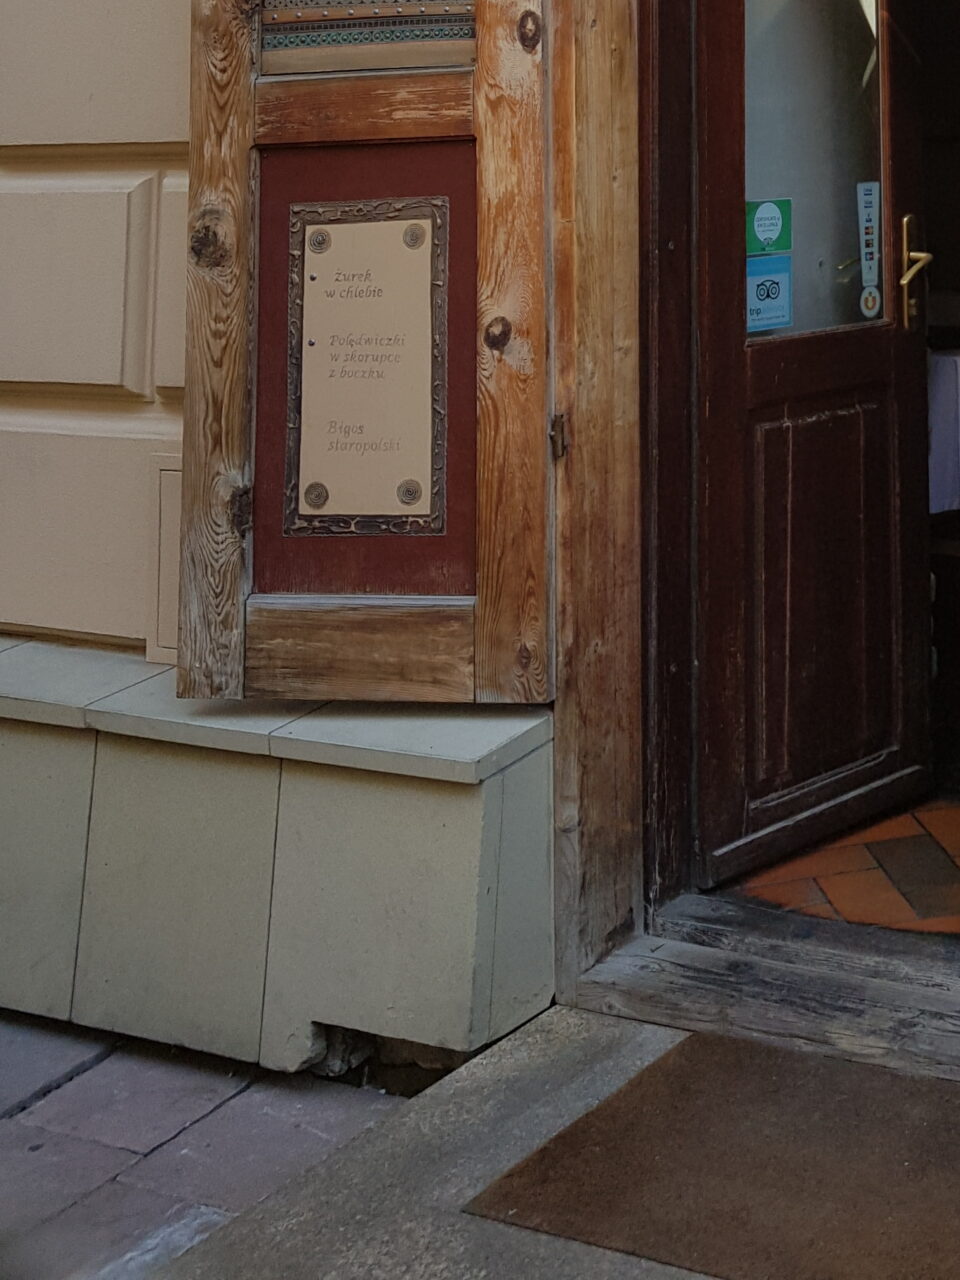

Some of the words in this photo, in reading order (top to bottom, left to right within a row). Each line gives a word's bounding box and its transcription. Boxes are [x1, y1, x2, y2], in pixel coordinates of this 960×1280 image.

[325, 290, 336, 299] w
[339, 286, 384, 300] chlebie
[329, 333, 406, 348] Polędwiczki
[329, 353, 340, 363] w
[328, 367, 337, 379] z
[340, 365, 385, 380] boczku
[327, 420, 365, 438] Bigos
[328, 438, 401, 457] staropolski
